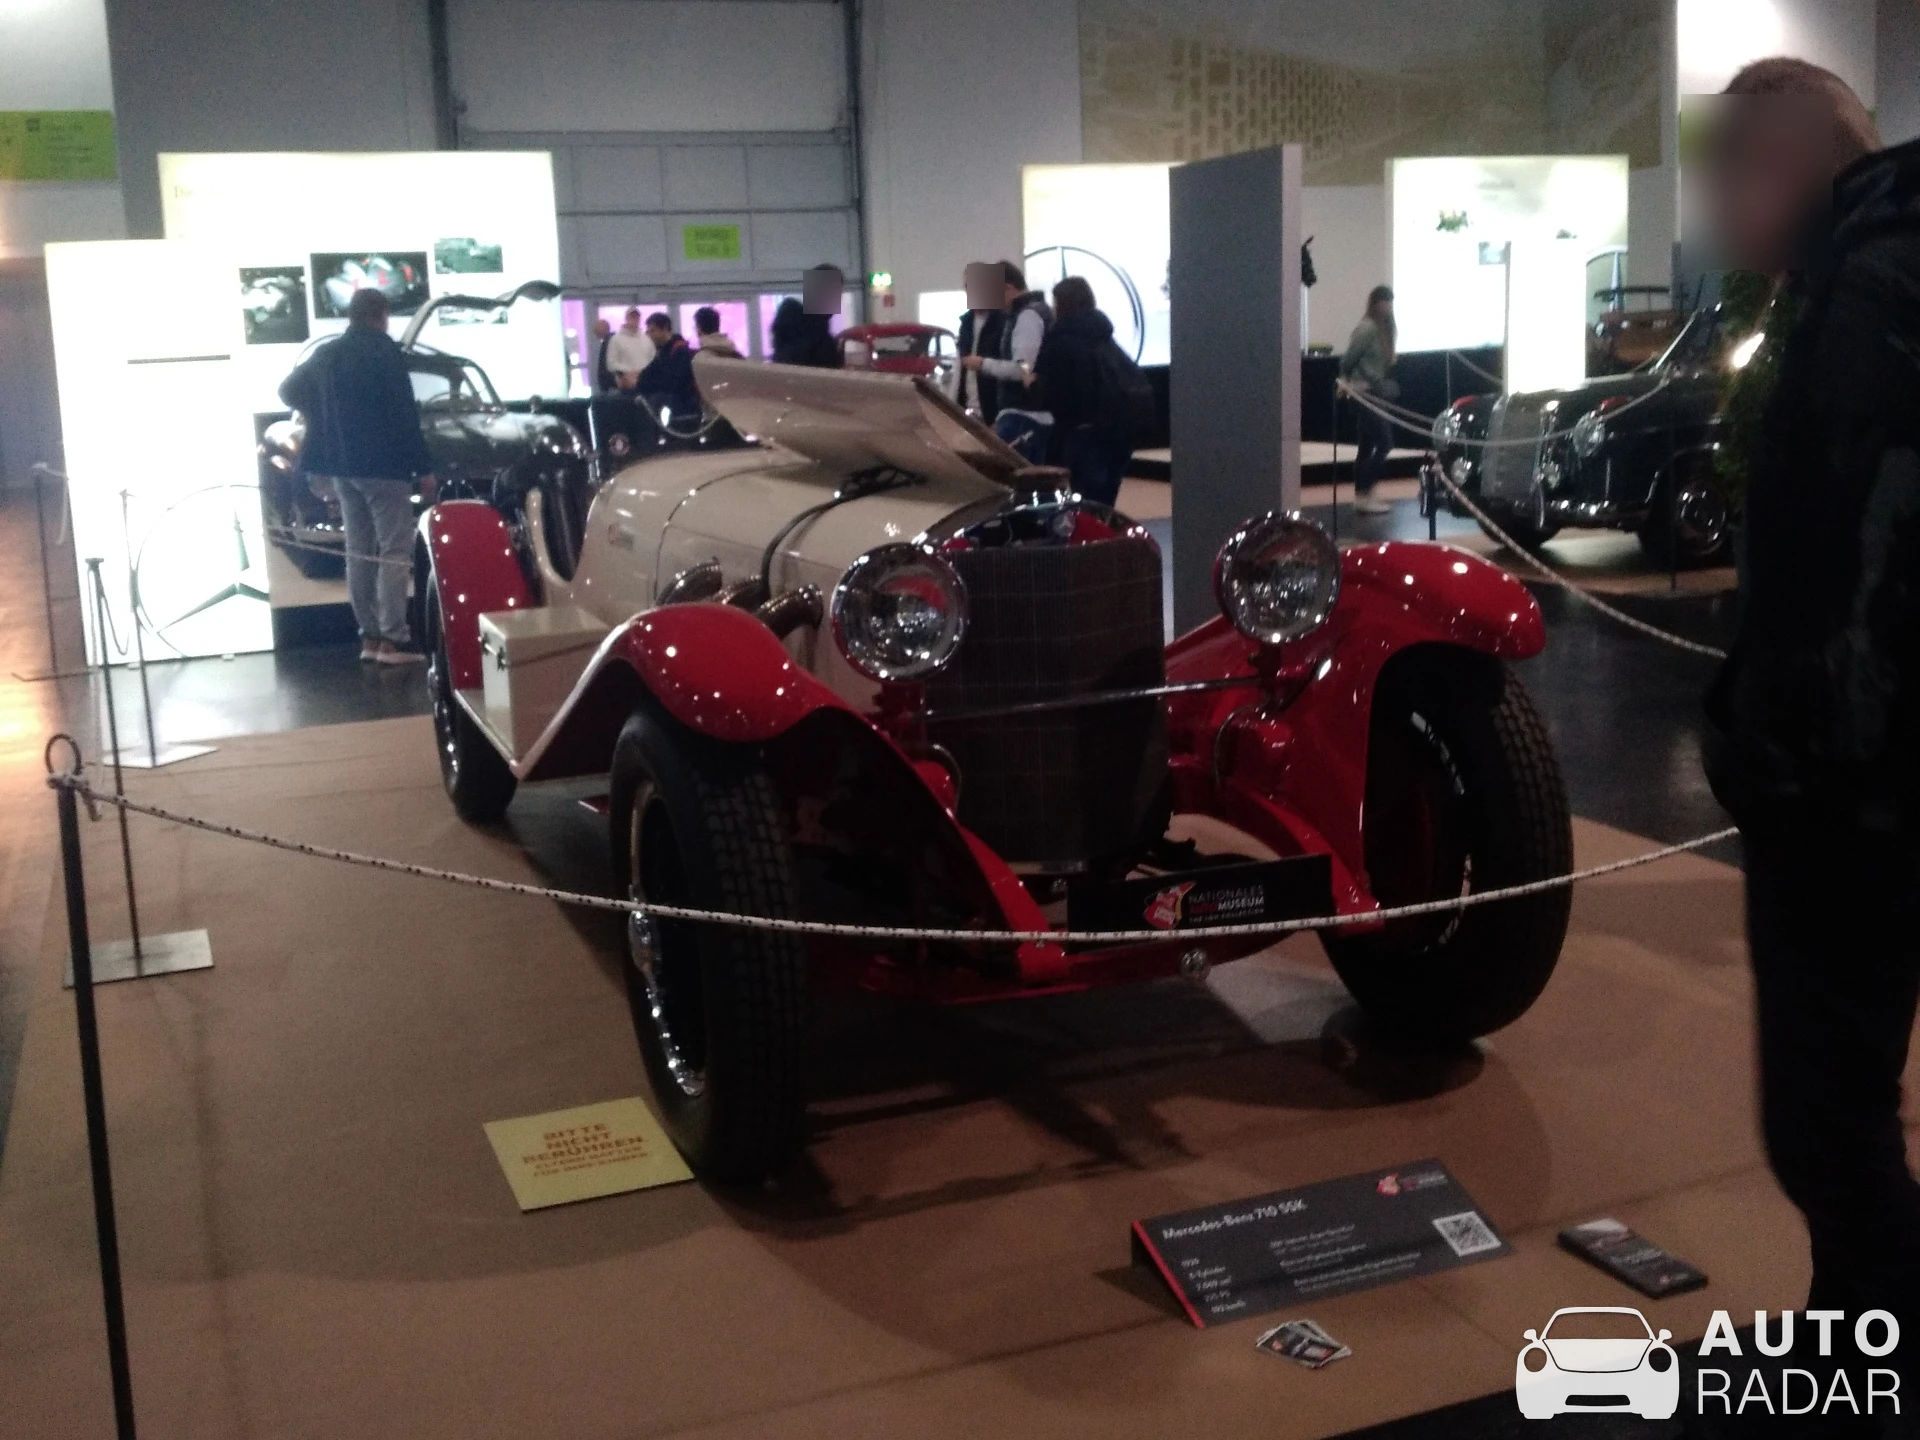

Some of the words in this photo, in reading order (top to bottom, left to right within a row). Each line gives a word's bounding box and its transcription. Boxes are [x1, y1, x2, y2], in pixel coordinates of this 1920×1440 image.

[1188, 885, 1264, 903] NATIONALES
[543, 1123, 607, 1140] BITTE
[546, 1131, 612, 1149] NICHT
